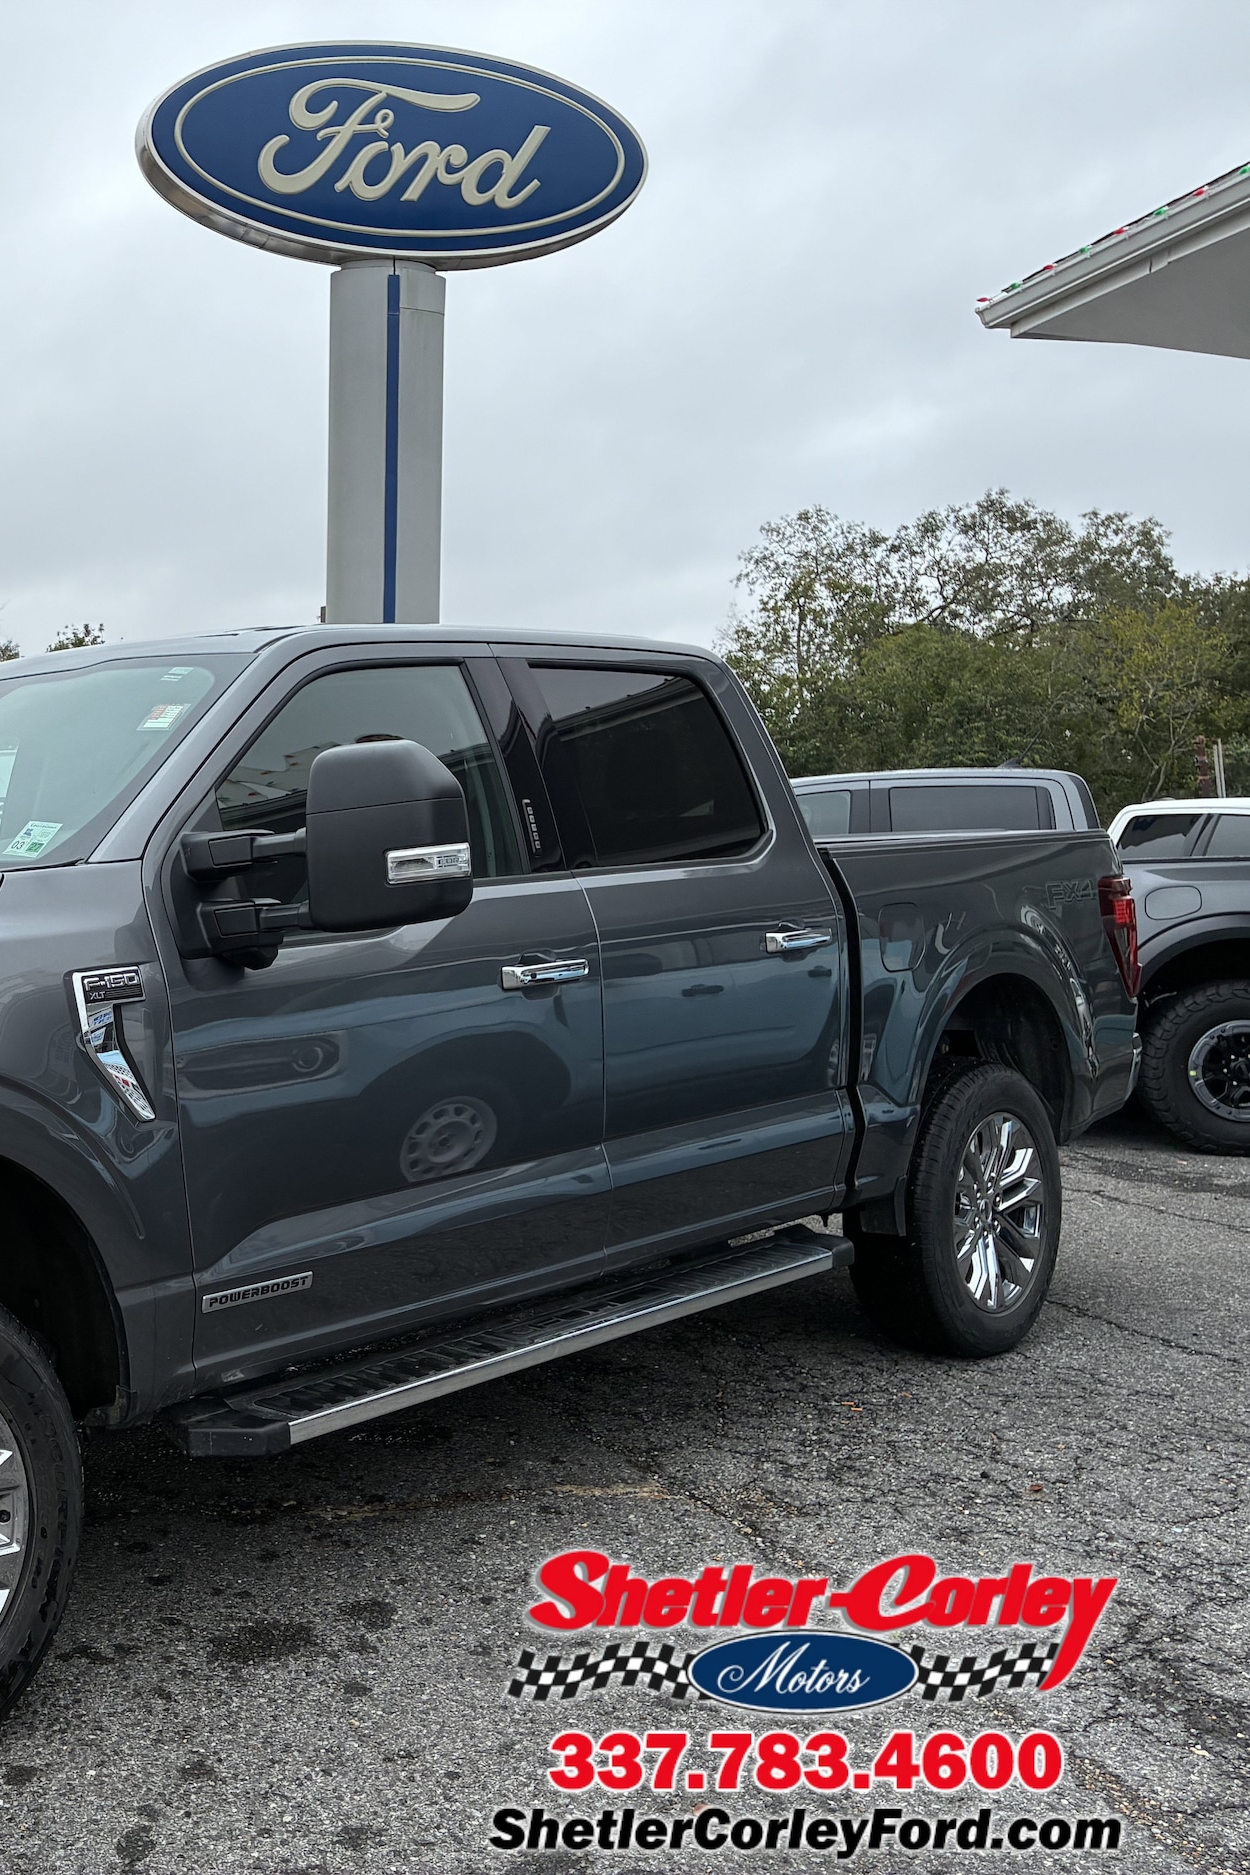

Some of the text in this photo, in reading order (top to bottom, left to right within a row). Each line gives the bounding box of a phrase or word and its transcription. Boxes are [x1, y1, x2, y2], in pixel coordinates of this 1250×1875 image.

[258, 77, 552, 209] Ford
[1046, 880, 1096, 909] FX4
[84, 973, 140, 991] F-150
[90, 991, 106, 1000] XLT
[209, 1276, 308, 1307] POWERBOOST
